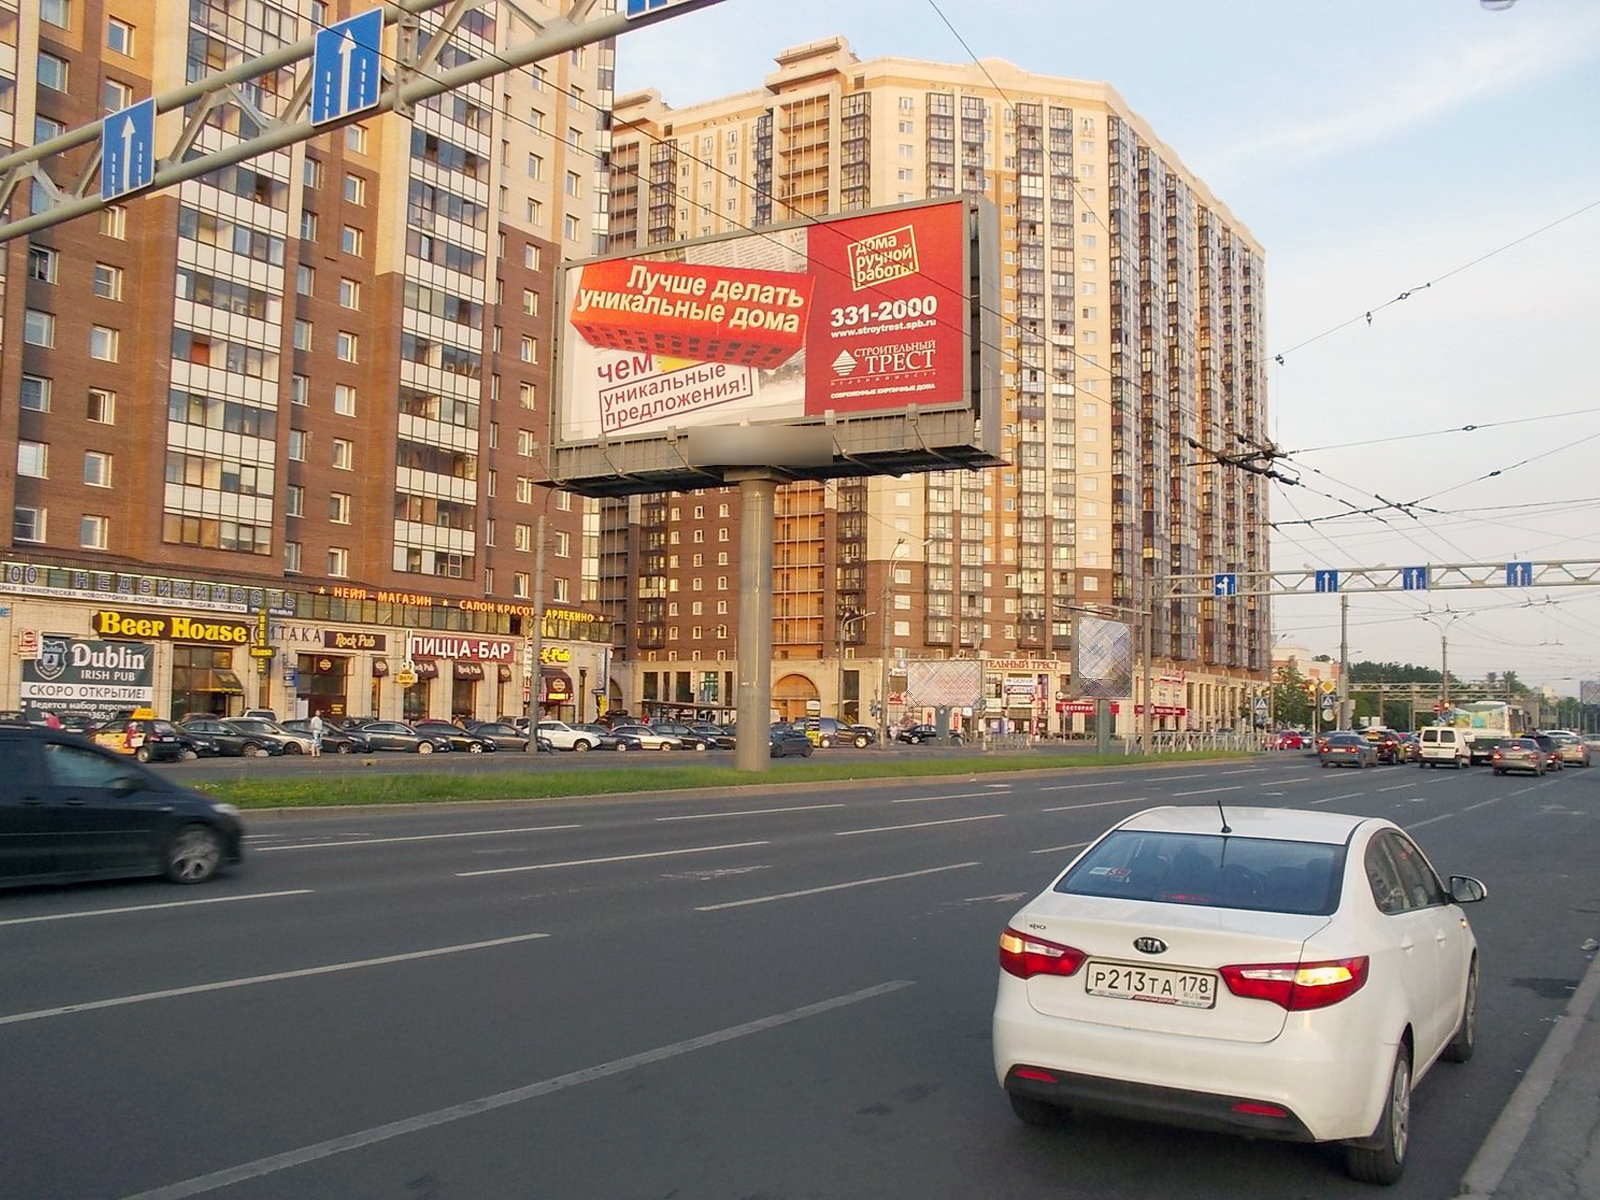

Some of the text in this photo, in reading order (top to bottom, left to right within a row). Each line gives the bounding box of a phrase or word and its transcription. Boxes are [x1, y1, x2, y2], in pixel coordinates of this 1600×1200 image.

[855, 235, 897, 256] дома
[856, 243, 913, 273] ручной
[857, 261, 914, 286] работы
[627, 265, 804, 308] Лучше делать
[576, 288, 801, 333] уникальные дома
[830, 295, 938, 327] 331-2000
[830, 318, 937, 338] www.stroytrest.spb.ru
[854, 339, 937, 358] СТРОИТЕЛЬНЫЙ
[597, 353, 653, 384] чем
[865, 350, 936, 375] ТРЕСТ
[603, 364, 727, 412] уникальные
[605, 373, 747, 428] предложения!
[75, 571, 297, 609] НЕДВИЖИМОСТЬ
[333, 586, 367, 600] НЕЙЛ
[377, 591, 432, 607] МАГАЗИН
[459, 600, 534, 617] САЛОН КРАСОТ
[545, 608, 594, 623] АРЛЕКИНО
[99, 611, 247, 643] Beer House
[335, 632, 376, 648] Rock Pub
[412, 637, 511, 659] ПИЦЦА-БАР
[71, 643, 146, 670] Dublin
[1030, 661, 1059, 669] ТРЕСТ
[81, 669, 136, 681] IRISH PUB
[29, 685, 146, 699] СКОРО ОТКРЫТИЕ!
[30, 700, 67, 709] Ведется
[69, 701, 97, 711] набор
[1137, 938, 1163, 952] KIA
[1178, 975, 1209, 994] 178
